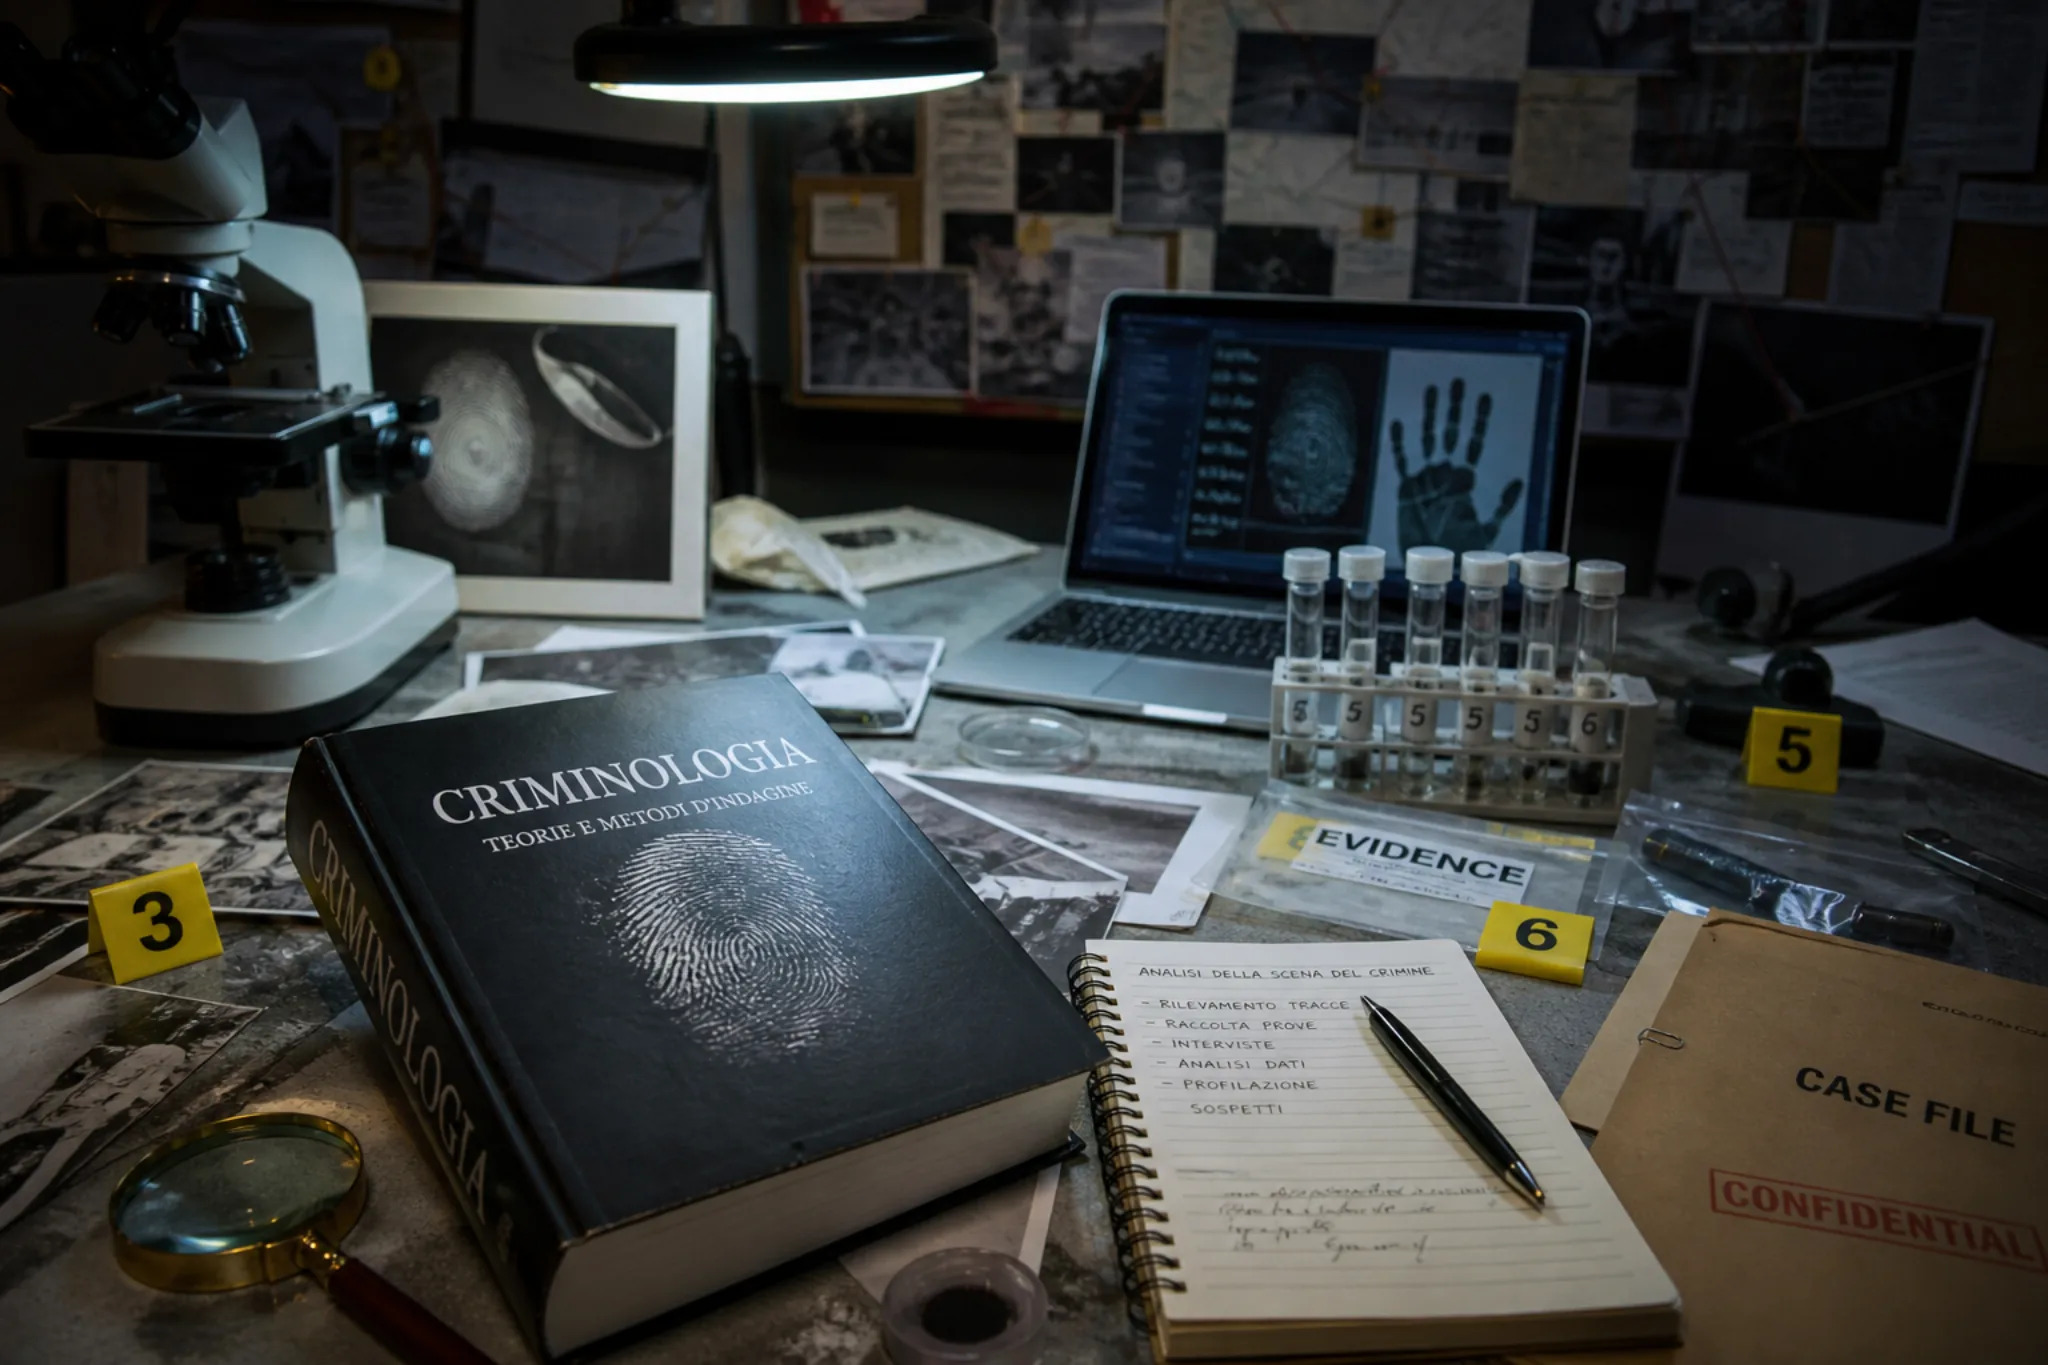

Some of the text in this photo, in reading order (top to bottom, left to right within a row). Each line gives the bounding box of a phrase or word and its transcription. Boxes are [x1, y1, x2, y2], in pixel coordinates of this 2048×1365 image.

[1346, 701, 1363, 722] 5
[1409, 704, 1426, 727] 5
[1465, 707, 1483, 730] 5
[1524, 710, 1542, 734] 5
[1580, 713, 1598, 735] 6
[1776, 725, 1812, 774] 5
[432, 736, 818, 825] CRIMINOLOGIA
[482, 780, 814, 853] TEORIE E METODI D'INDAGINE
[1315, 829, 1526, 886] EVIDENCE
[133, 891, 184, 952] 3
[1515, 918, 1558, 951] 6
[1139, 966, 1435, 980] ANALISI DELLA SCENA DEL CRIMINE
[1160, 1000, 1350, 1011] RILEVAMENTO TRACCE
[308, 819, 488, 1225] CRIMINOLOGIA
[1165, 1019, 1318, 1031] RACCOLTA PROVE
[1172, 1039, 1275, 1050] INTERVISTE
[1178, 1058, 1306, 1070] ANALISI DATI
[1183, 1079, 1320, 1091] PROFILAZIONE
[1190, 1104, 1284, 1115] SOSPETTI
[1796, 1066, 2017, 1148] CASE FILE
[1722, 1180, 2036, 1263] CONFIDENTIAL
